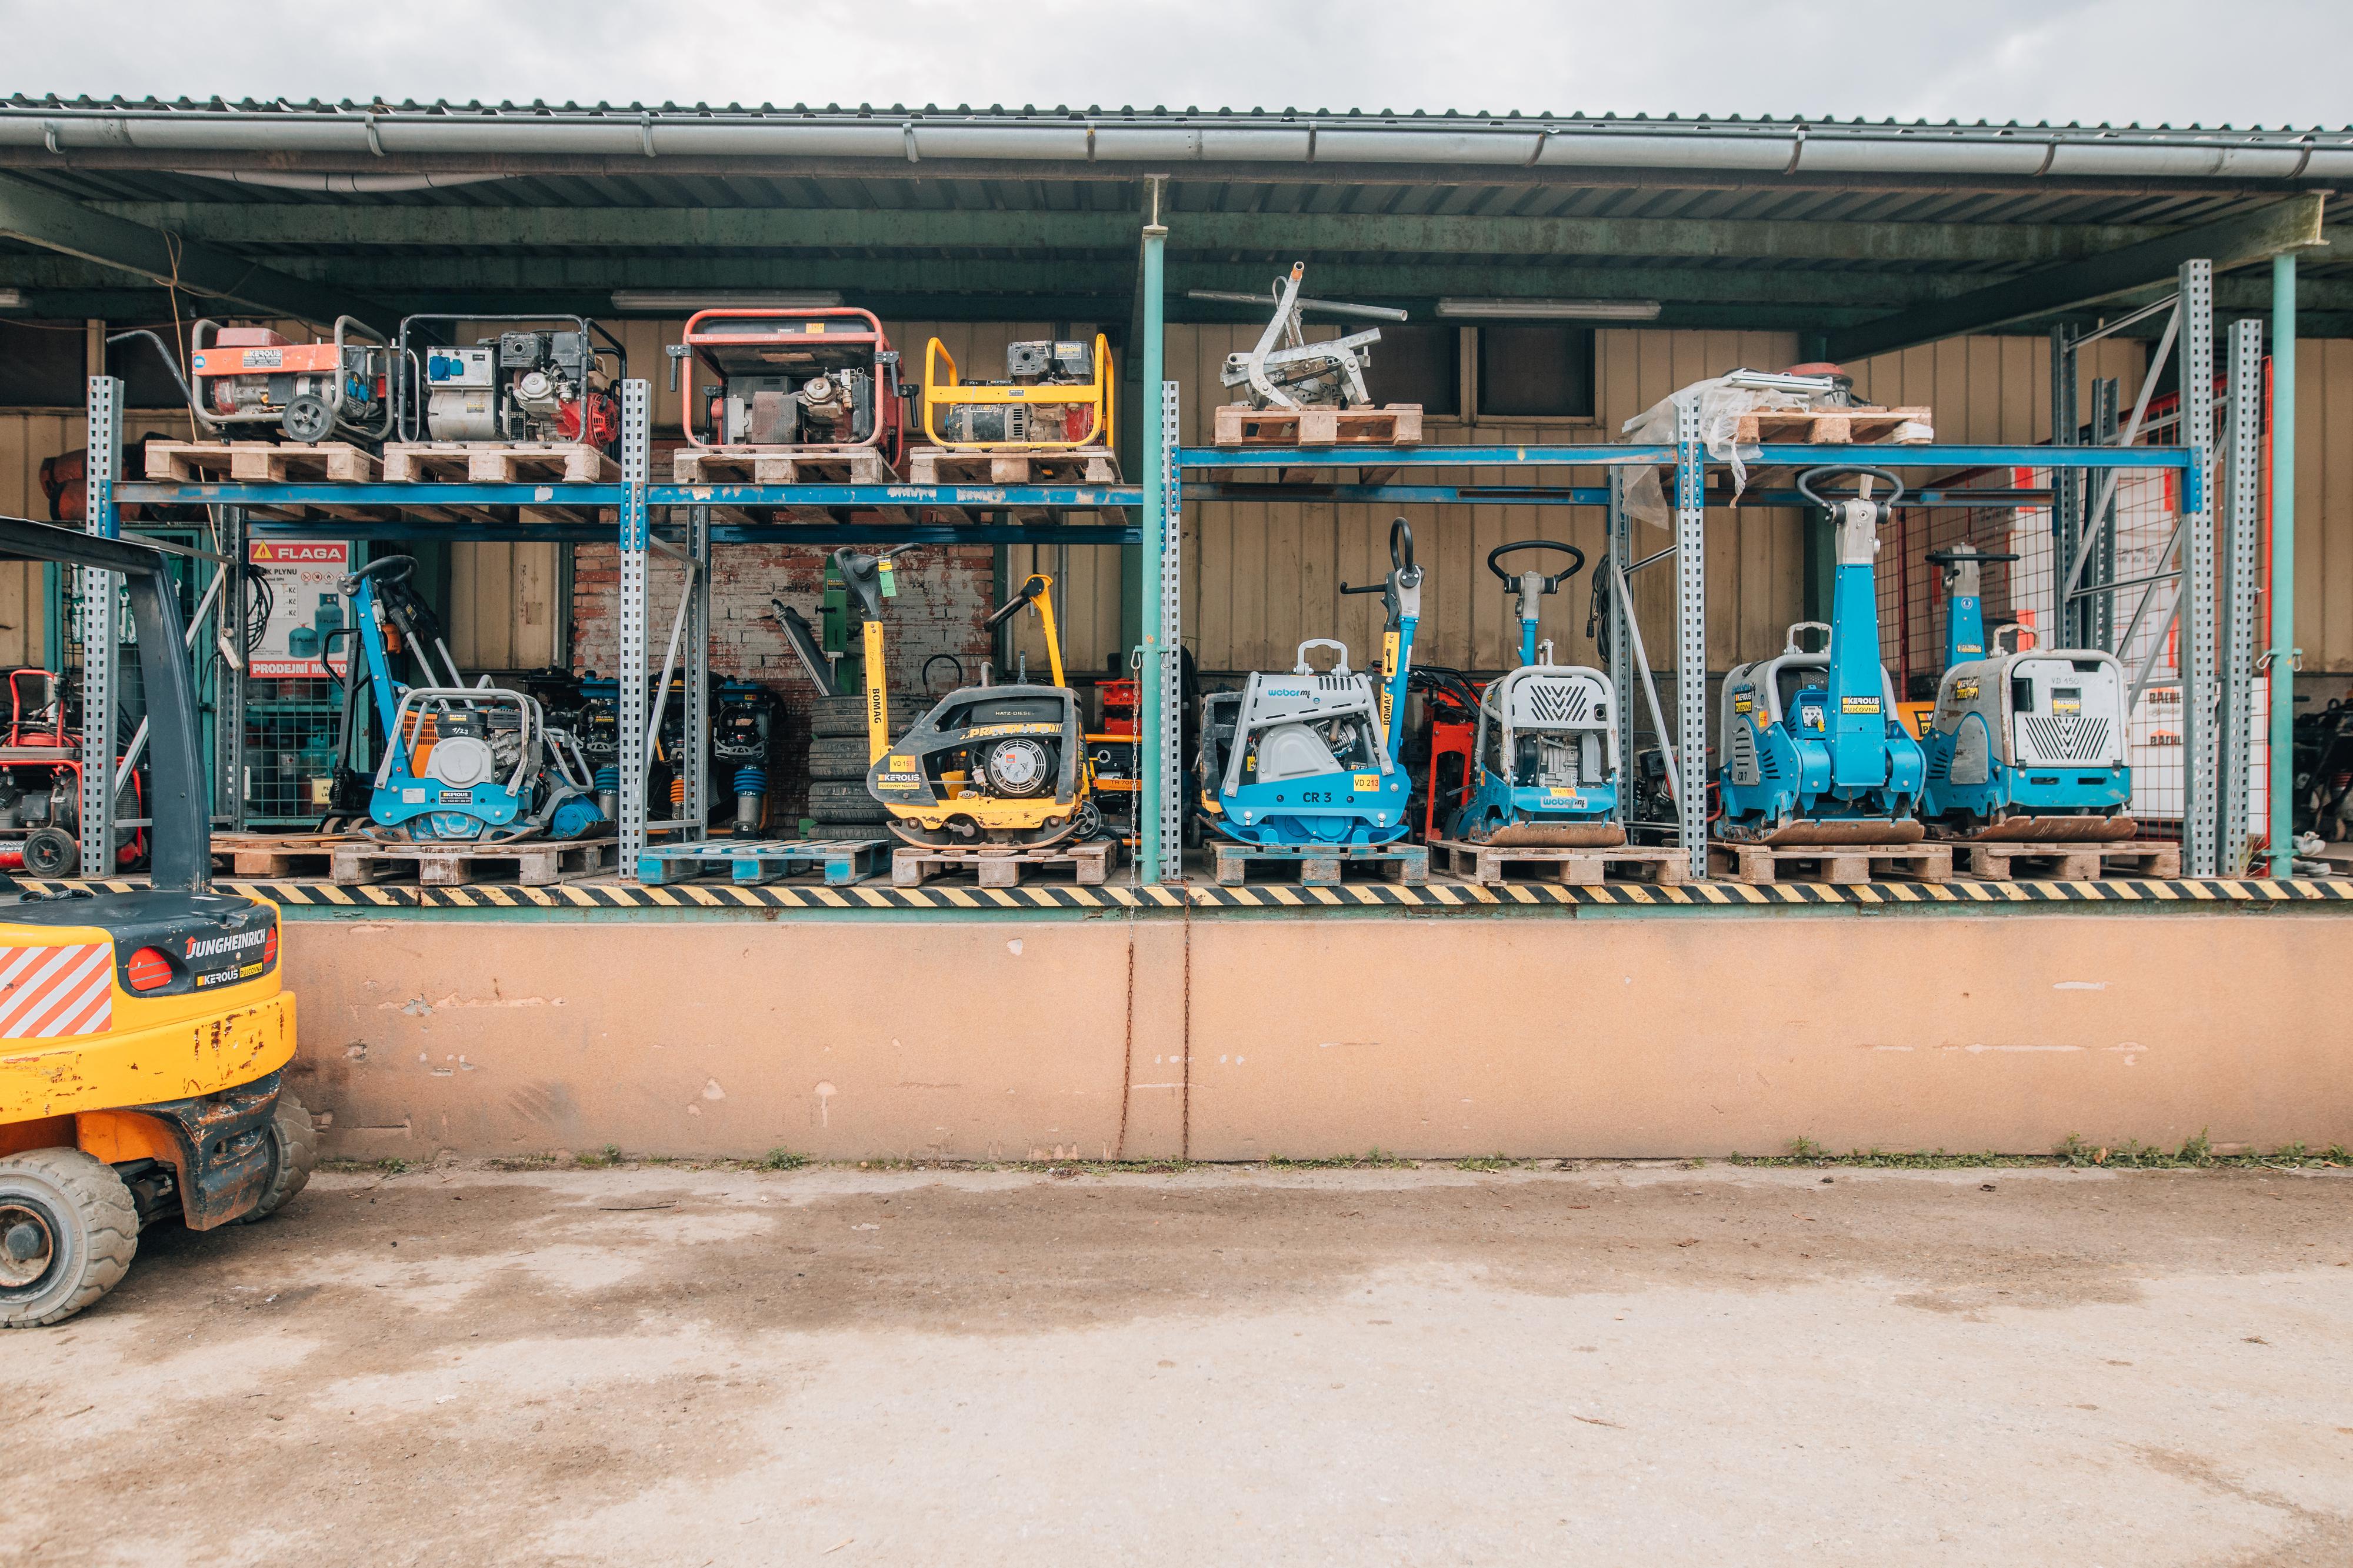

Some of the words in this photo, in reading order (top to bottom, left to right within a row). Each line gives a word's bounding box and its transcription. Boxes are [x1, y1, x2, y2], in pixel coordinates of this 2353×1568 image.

[278, 548, 342, 559] FLAGA
[252, 662, 309, 674] PRODEJNÍ
[311, 663, 347, 673] MTO
[872, 688, 882, 724] BOMAG
[1738, 771, 1744, 781] CR
[1744, 771, 1747, 781] 7
[1303, 792, 1319, 803] CR
[1324, 792, 1332, 803] 3
[185, 928, 266, 959] JUNGHEINRICH
[204, 969, 238, 985] KEROUS
